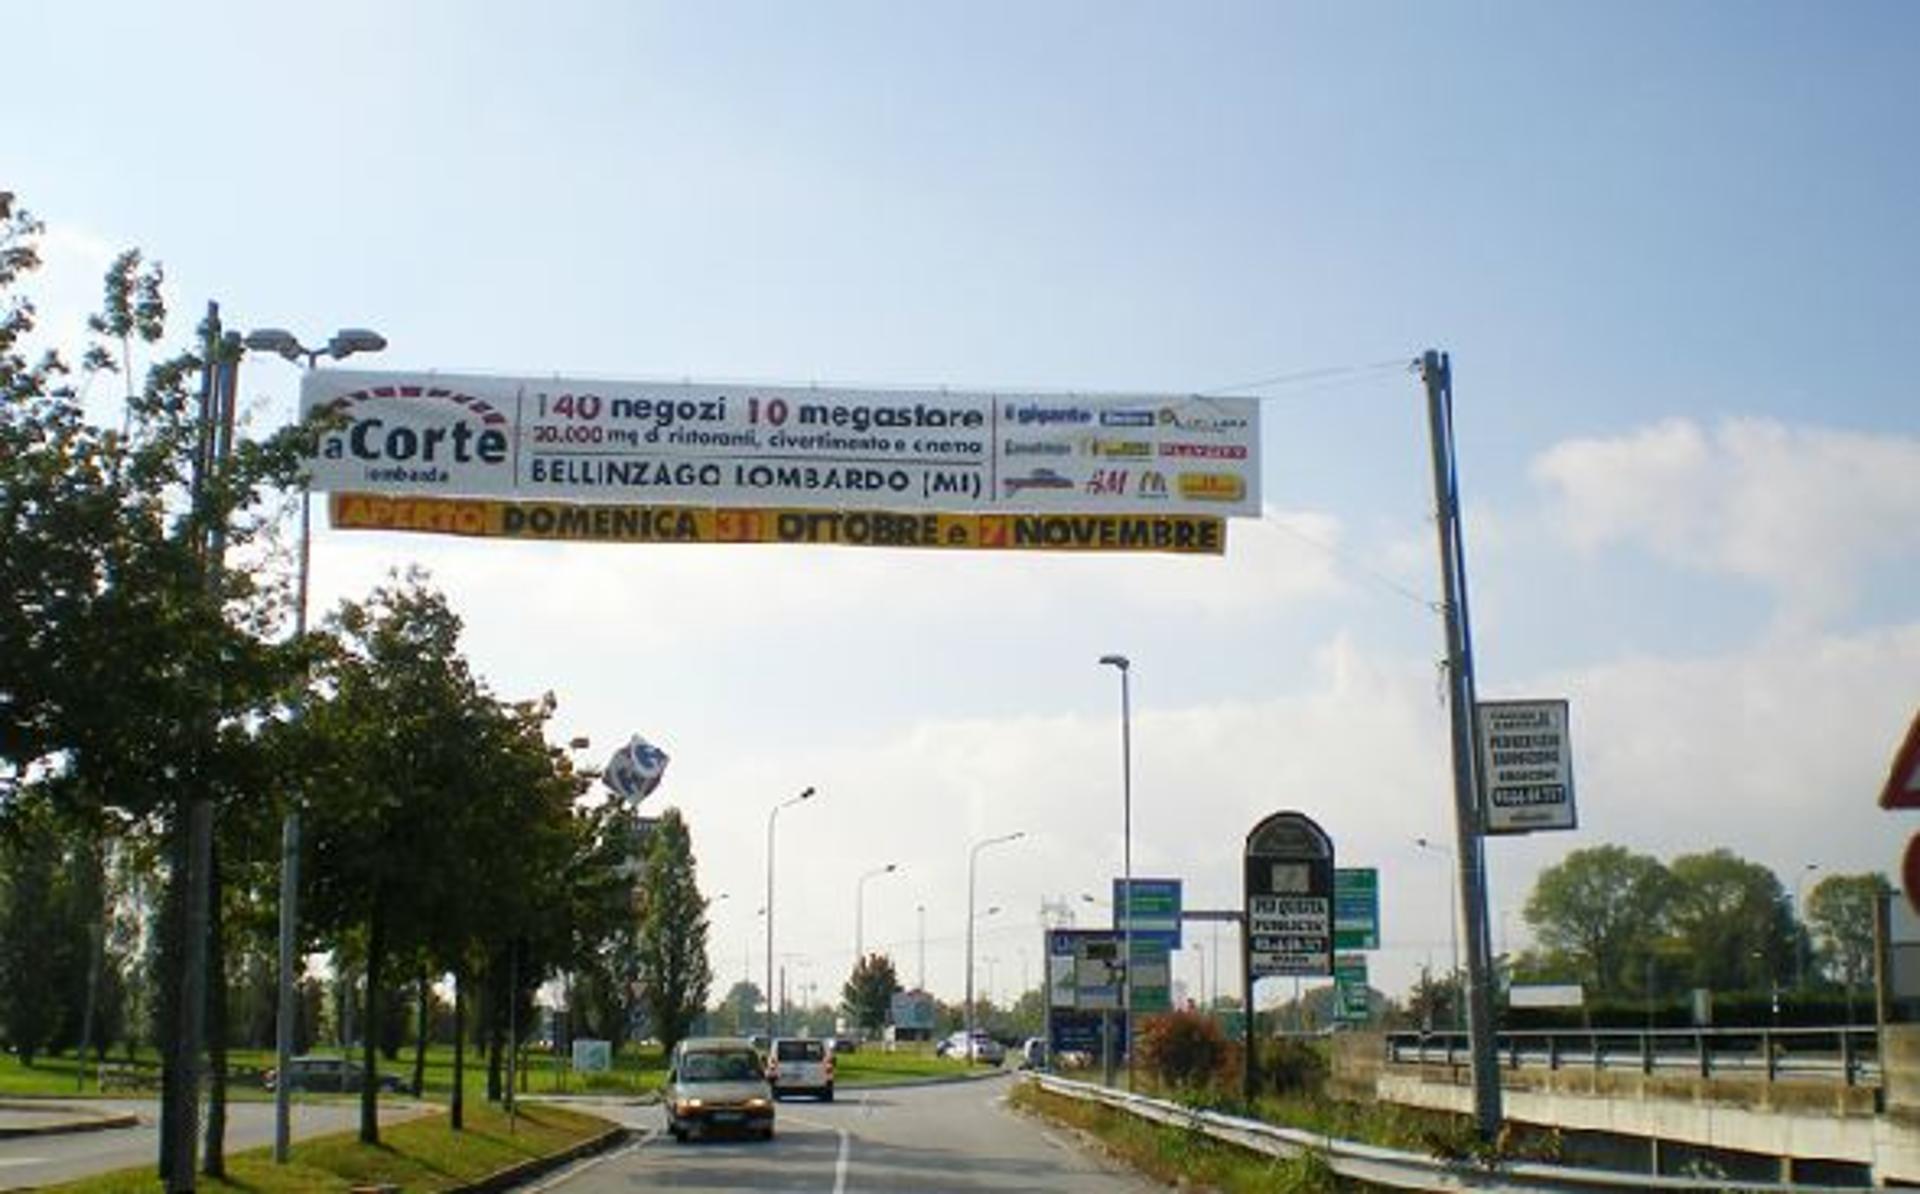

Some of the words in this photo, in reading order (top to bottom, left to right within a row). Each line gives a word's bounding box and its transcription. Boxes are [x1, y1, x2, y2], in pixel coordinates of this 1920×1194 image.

[611, 396, 726, 427] negozi
[749, 397, 788, 427] 10
[799, 403, 984, 432] megastore
[532, 458, 721, 487] BELLINZAGO
[735, 464, 909, 493] LOMBARDO
[922, 469, 982, 498] (MI)
[503, 504, 699, 538] DOMENICA
[777, 513, 938, 544] OTTOBRE
[948, 522, 967, 542] e
[1012, 516, 1217, 549] NOVEMBRE
